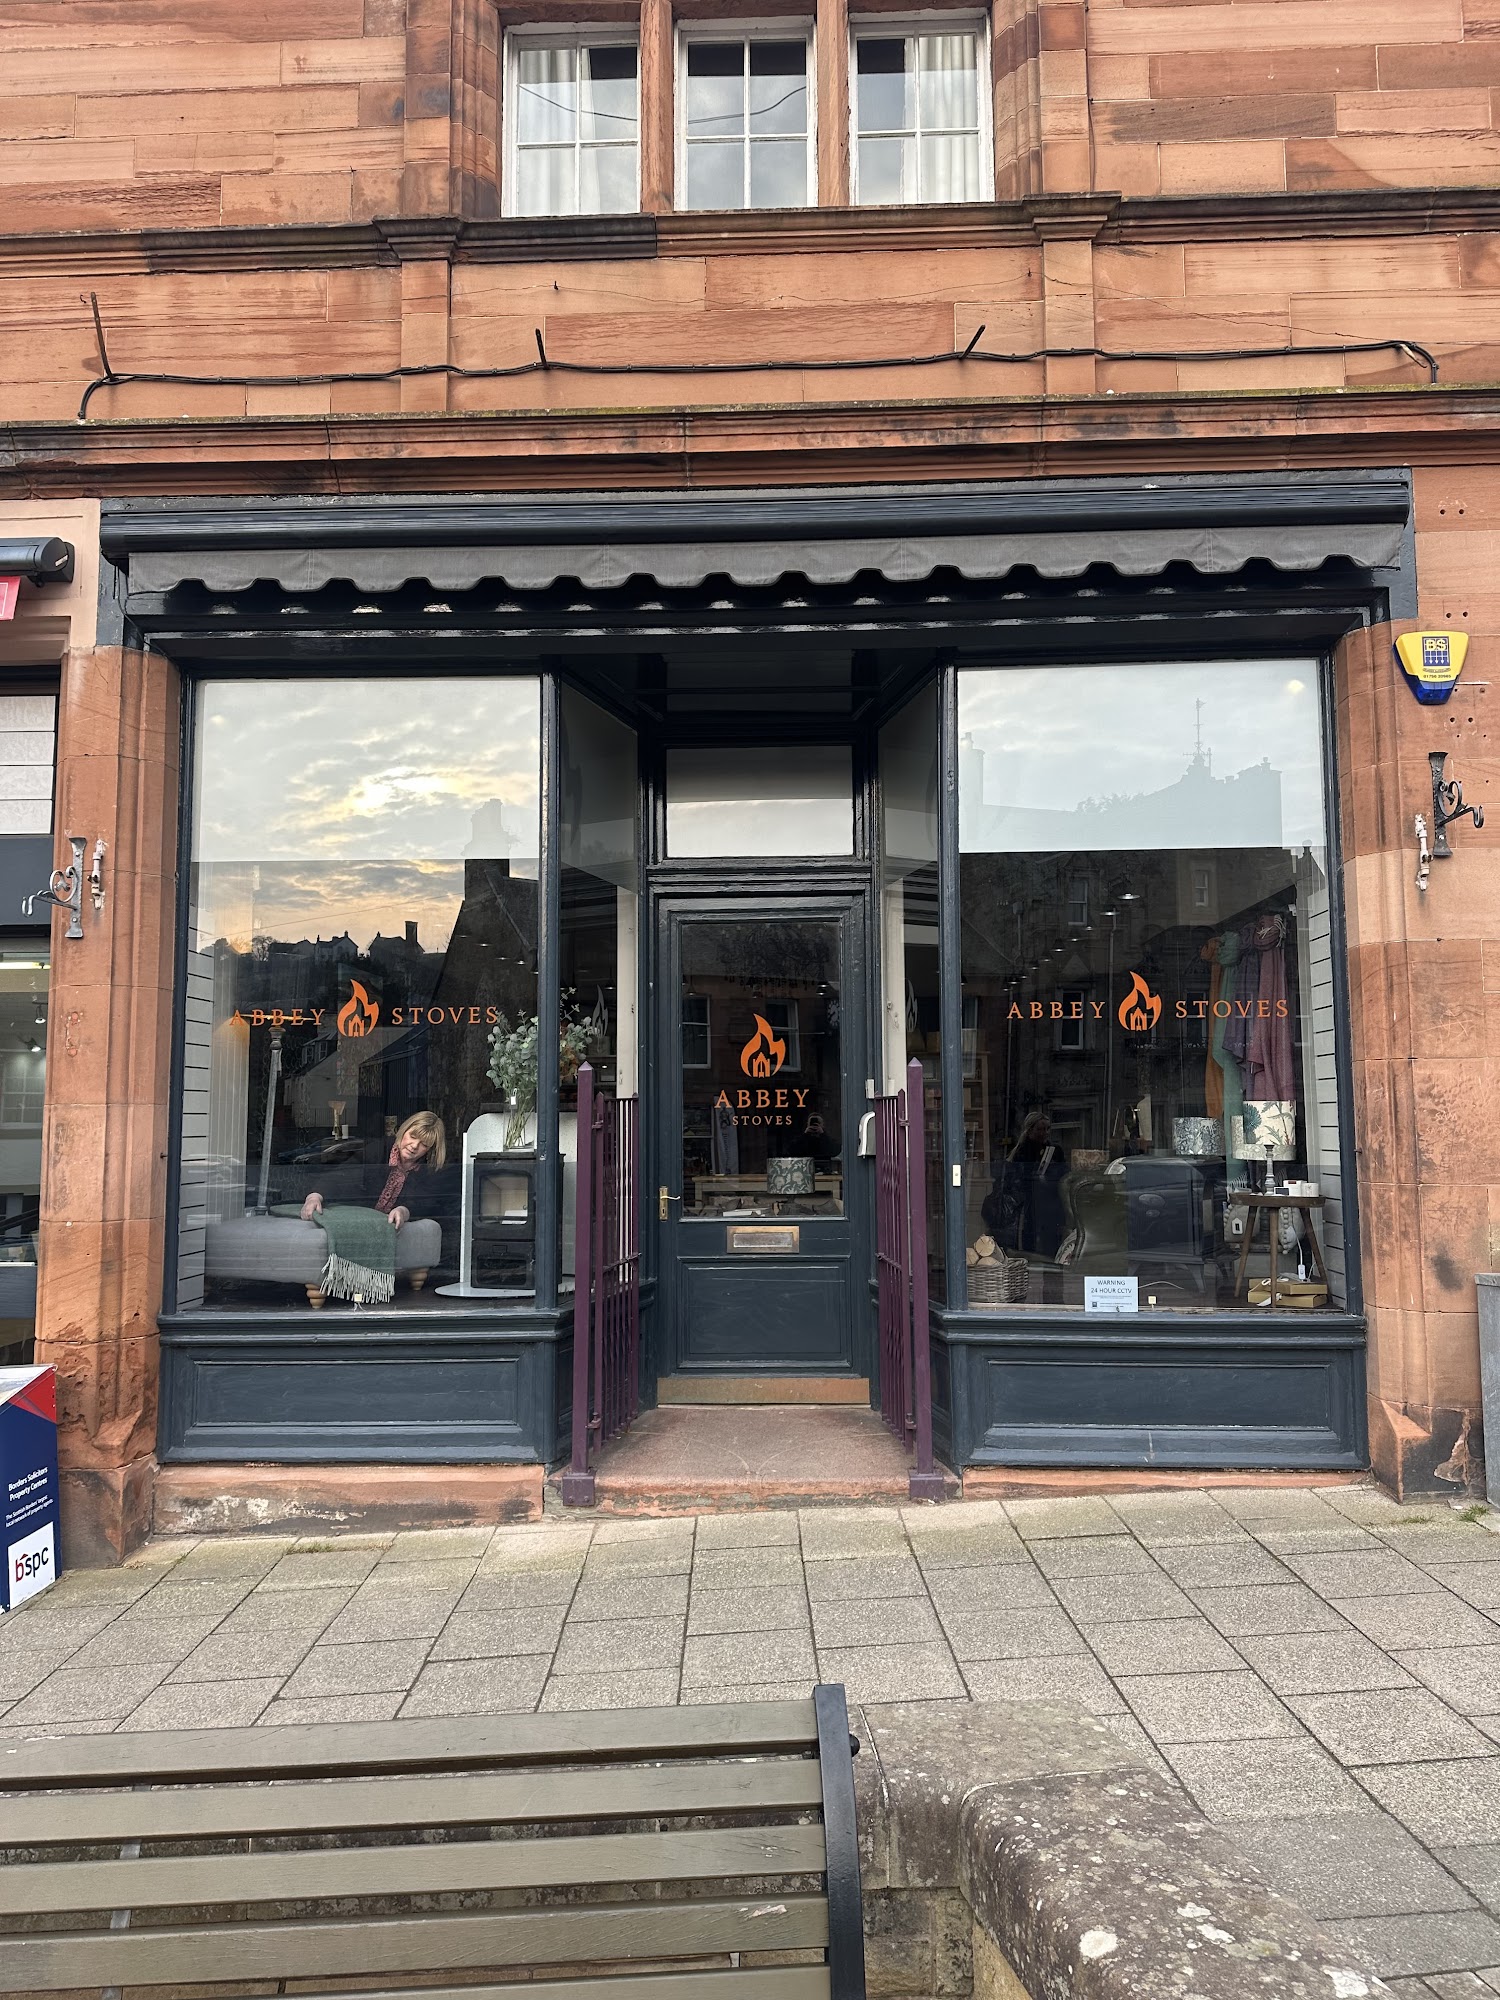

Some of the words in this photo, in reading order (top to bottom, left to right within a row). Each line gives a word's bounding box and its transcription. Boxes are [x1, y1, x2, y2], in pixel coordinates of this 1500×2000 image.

[228, 1008, 326, 1027] ABBEY
[391, 1006, 498, 1026] STOVES
[1006, 1001, 1106, 1019] ABBEY
[1175, 1000, 1289, 1019] STOVES
[714, 1089, 810, 1109] ABBEY
[732, 1115, 793, 1126] STOVES
[8, 1477, 28, 1492] Borders
[9, 1486, 31, 1502] Property
[30, 1477, 48, 1491] Centres
[15, 1547, 49, 1583] bspc
